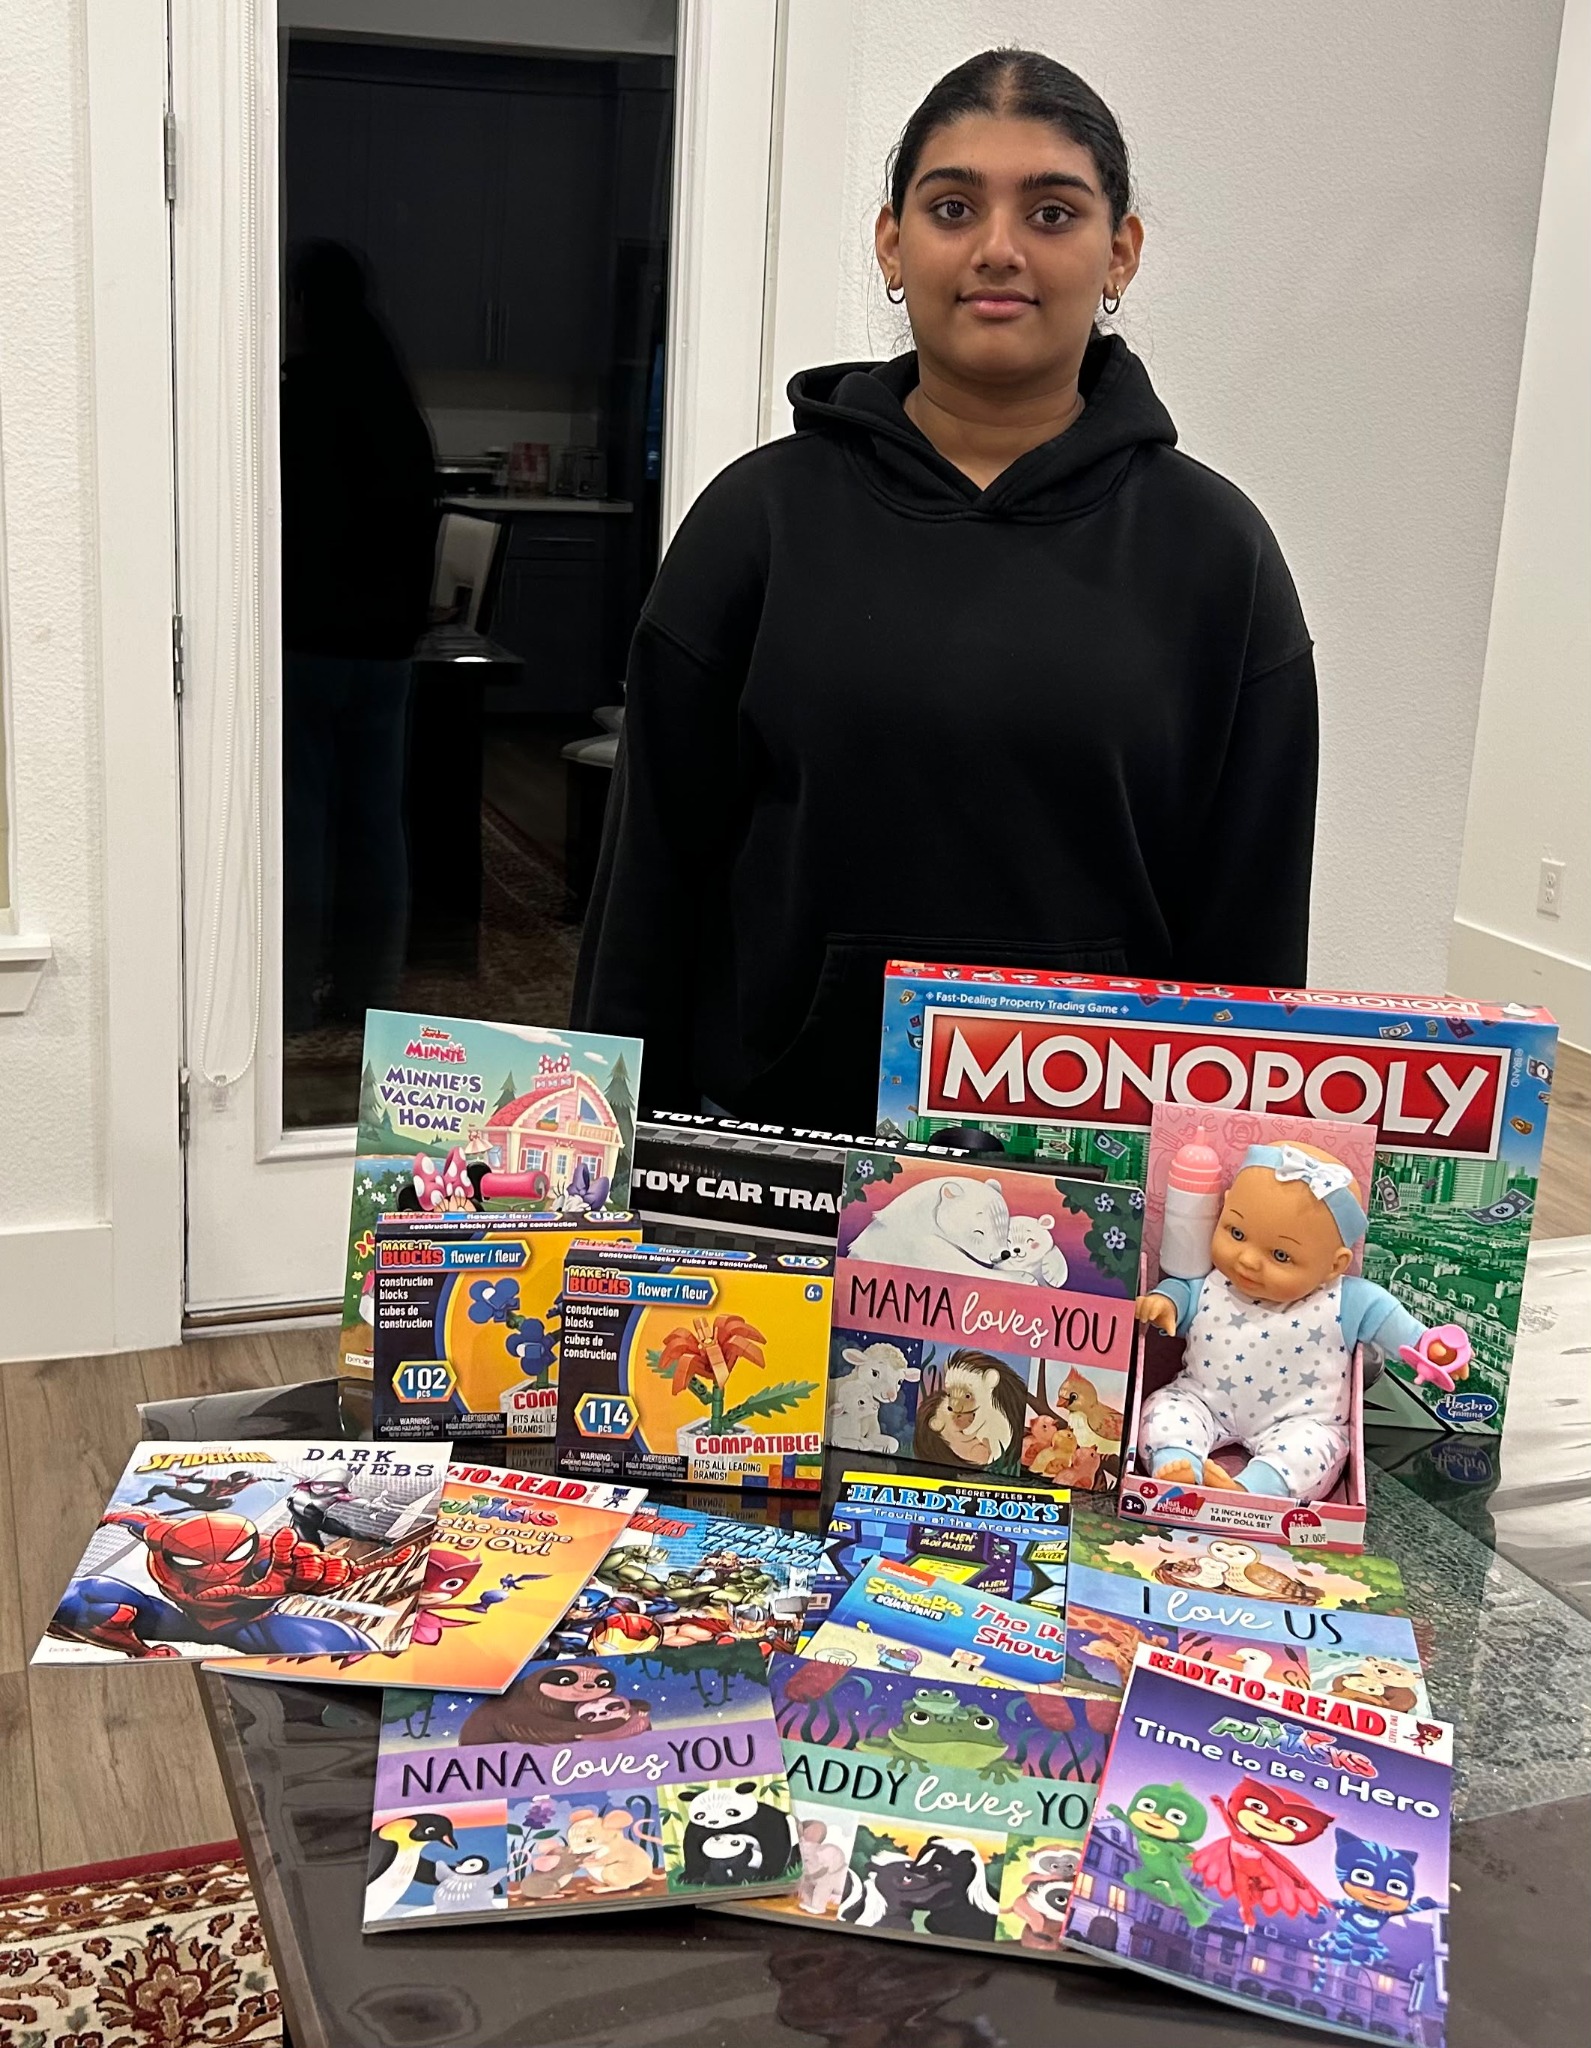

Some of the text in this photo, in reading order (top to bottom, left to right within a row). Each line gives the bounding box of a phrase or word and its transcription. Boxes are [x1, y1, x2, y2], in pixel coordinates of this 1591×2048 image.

[935, 991, 1118, 1014] Fast-Dealing Property Trading Game
[1278, 991, 1474, 1015] MONOPOLY
[405, 1040, 466, 1063] MINNIE
[385, 1066, 482, 1093] MINNIE'S
[942, 1025, 1489, 1137] MONOPOLY
[380, 1085, 486, 1115] VACATION
[399, 1108, 462, 1133] HOME
[652, 1110, 970, 1158] TOY CAR TRACK SET
[632, 1168, 842, 1215] TOY CAR TRA
[382, 1241, 430, 1251] MAKE-IT
[382, 1250, 443, 1265] BLOCKS
[450, 1249, 486, 1264] flower
[495, 1249, 521, 1264] fleur
[570, 1268, 619, 1279] MAKE-IT
[379, 1276, 434, 1287] construction
[569, 1278, 631, 1295] BLOCKS
[379, 1288, 409, 1299] blocks
[637, 1282, 673, 1297] flower
[682, 1284, 708, 1300] fleur
[806, 1286, 822, 1299] 6+
[379, 1304, 419, 1316] cubes de
[565, 1304, 620, 1318] construction
[849, 1275, 1117, 1354] MAMA loves YOU
[379, 1318, 433, 1329] construction
[564, 1316, 594, 1329] blocks
[564, 1335, 604, 1347] cubes de
[563, 1348, 618, 1361] construction
[403, 1368, 447, 1390] 102
[416, 1390, 431, 1399] pcs
[1440, 1396, 1493, 1412] Hasbro
[512, 1414, 529, 1424] FITS
[530, 1414, 545, 1424] ALL
[586, 1401, 630, 1426] 114
[597, 1425, 612, 1434] pcs
[695, 1434, 820, 1455] COMPATIBLE!
[134, 1451, 277, 1474] SPIDER-MAN
[302, 1448, 396, 1462] DARK
[346, 1463, 435, 1477] WEBS
[694, 1459, 711, 1469] FITS
[712, 1460, 727, 1471] ALL
[728, 1461, 761, 1473] LEADING
[693, 1470, 728, 1481] BRANDS!
[955, 1488, 991, 1498] SECRET
[995, 1492, 1023, 1501] FILES
[1142, 1486, 1155, 1495] 2+
[848, 1484, 1060, 1523] HARDY BOYS
[1126, 1500, 1134, 1510] 3
[873, 1507, 1031, 1535] Trouble at the Arcade
[1210, 1515, 1271, 1529] BABY DOLL SET
[1221, 1509, 1241, 1517] INCH
[1243, 1511, 1273, 1521] LOVELY
[494, 1527, 536, 1539] and
[536, 1531, 573, 1543] the
[941, 1531, 975, 1542] ALIEN
[486, 1536, 553, 1556] Owl
[978, 1579, 1008, 1589] ALIEN
[973, 1603, 1029, 1633] The
[1143, 1585, 1343, 1645] I love US
[974, 1626, 1064, 1663] Show
[400, 1733, 755, 1798] NANA loves YOU
[1134, 1717, 1441, 1819] Time to Be a Hero
[782, 1754, 1097, 1830] ADDY loves YO
